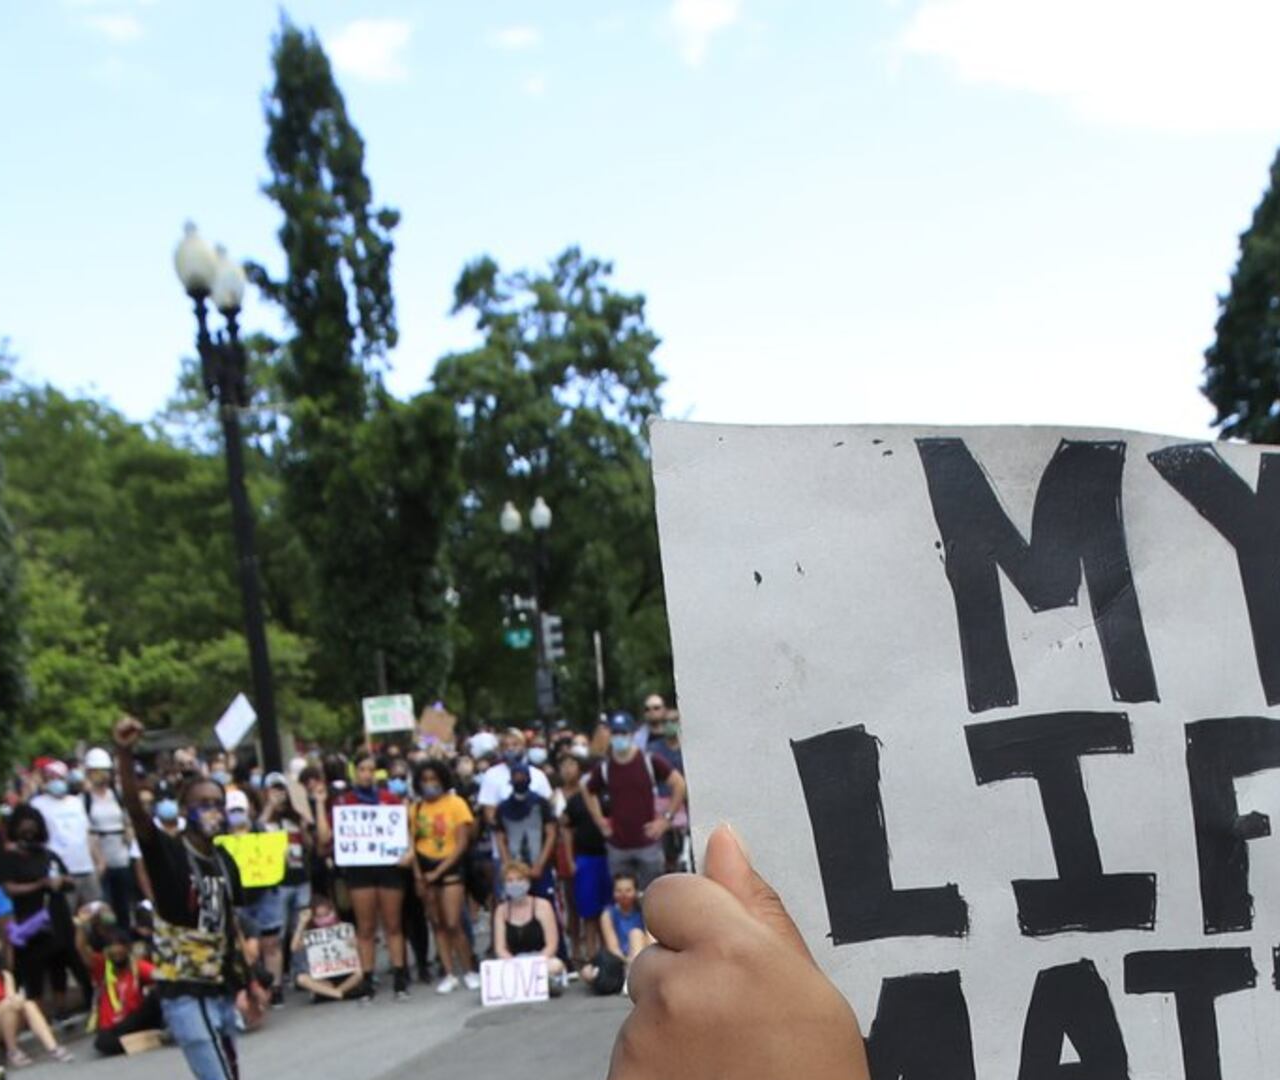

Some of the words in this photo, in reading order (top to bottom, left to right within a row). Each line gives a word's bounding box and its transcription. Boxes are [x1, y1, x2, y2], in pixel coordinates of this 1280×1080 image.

[340, 810, 377, 822] STOP
[339, 840, 358, 853] US
[322, 944, 341, 960] IS
[484, 960, 548, 1002] LOVE
